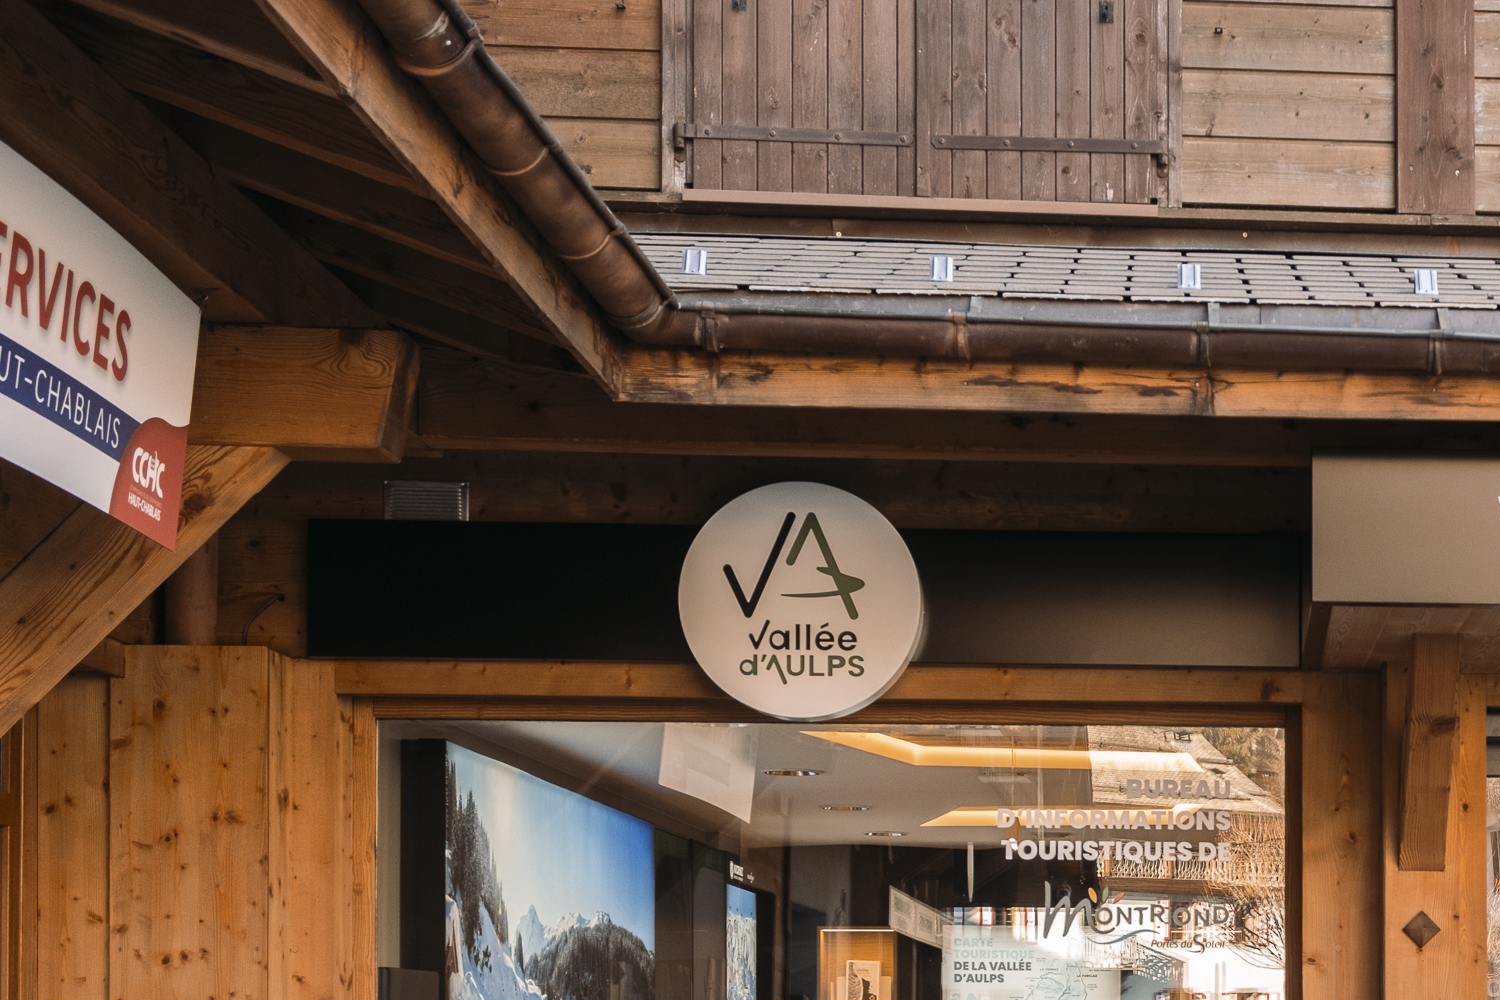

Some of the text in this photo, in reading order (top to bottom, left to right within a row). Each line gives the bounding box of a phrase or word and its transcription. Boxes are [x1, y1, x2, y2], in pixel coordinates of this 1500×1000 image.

[128, 492, 161, 521] HAUT-CHABLAIS
[748, 619, 858, 651] Vallée
[1126, 778, 1231, 800] BUREAU
[997, 808, 1231, 831] D'INFORMATIONS
[1001, 839, 1231, 862] TOURISTIQUES DE
[954, 938, 993, 947] CARTE
[1151, 933, 1225, 954] Portes du Soleil
[954, 950, 1034, 960] TOURISTIQUE
[954, 959, 1032, 971] DE LA VALLÉE
